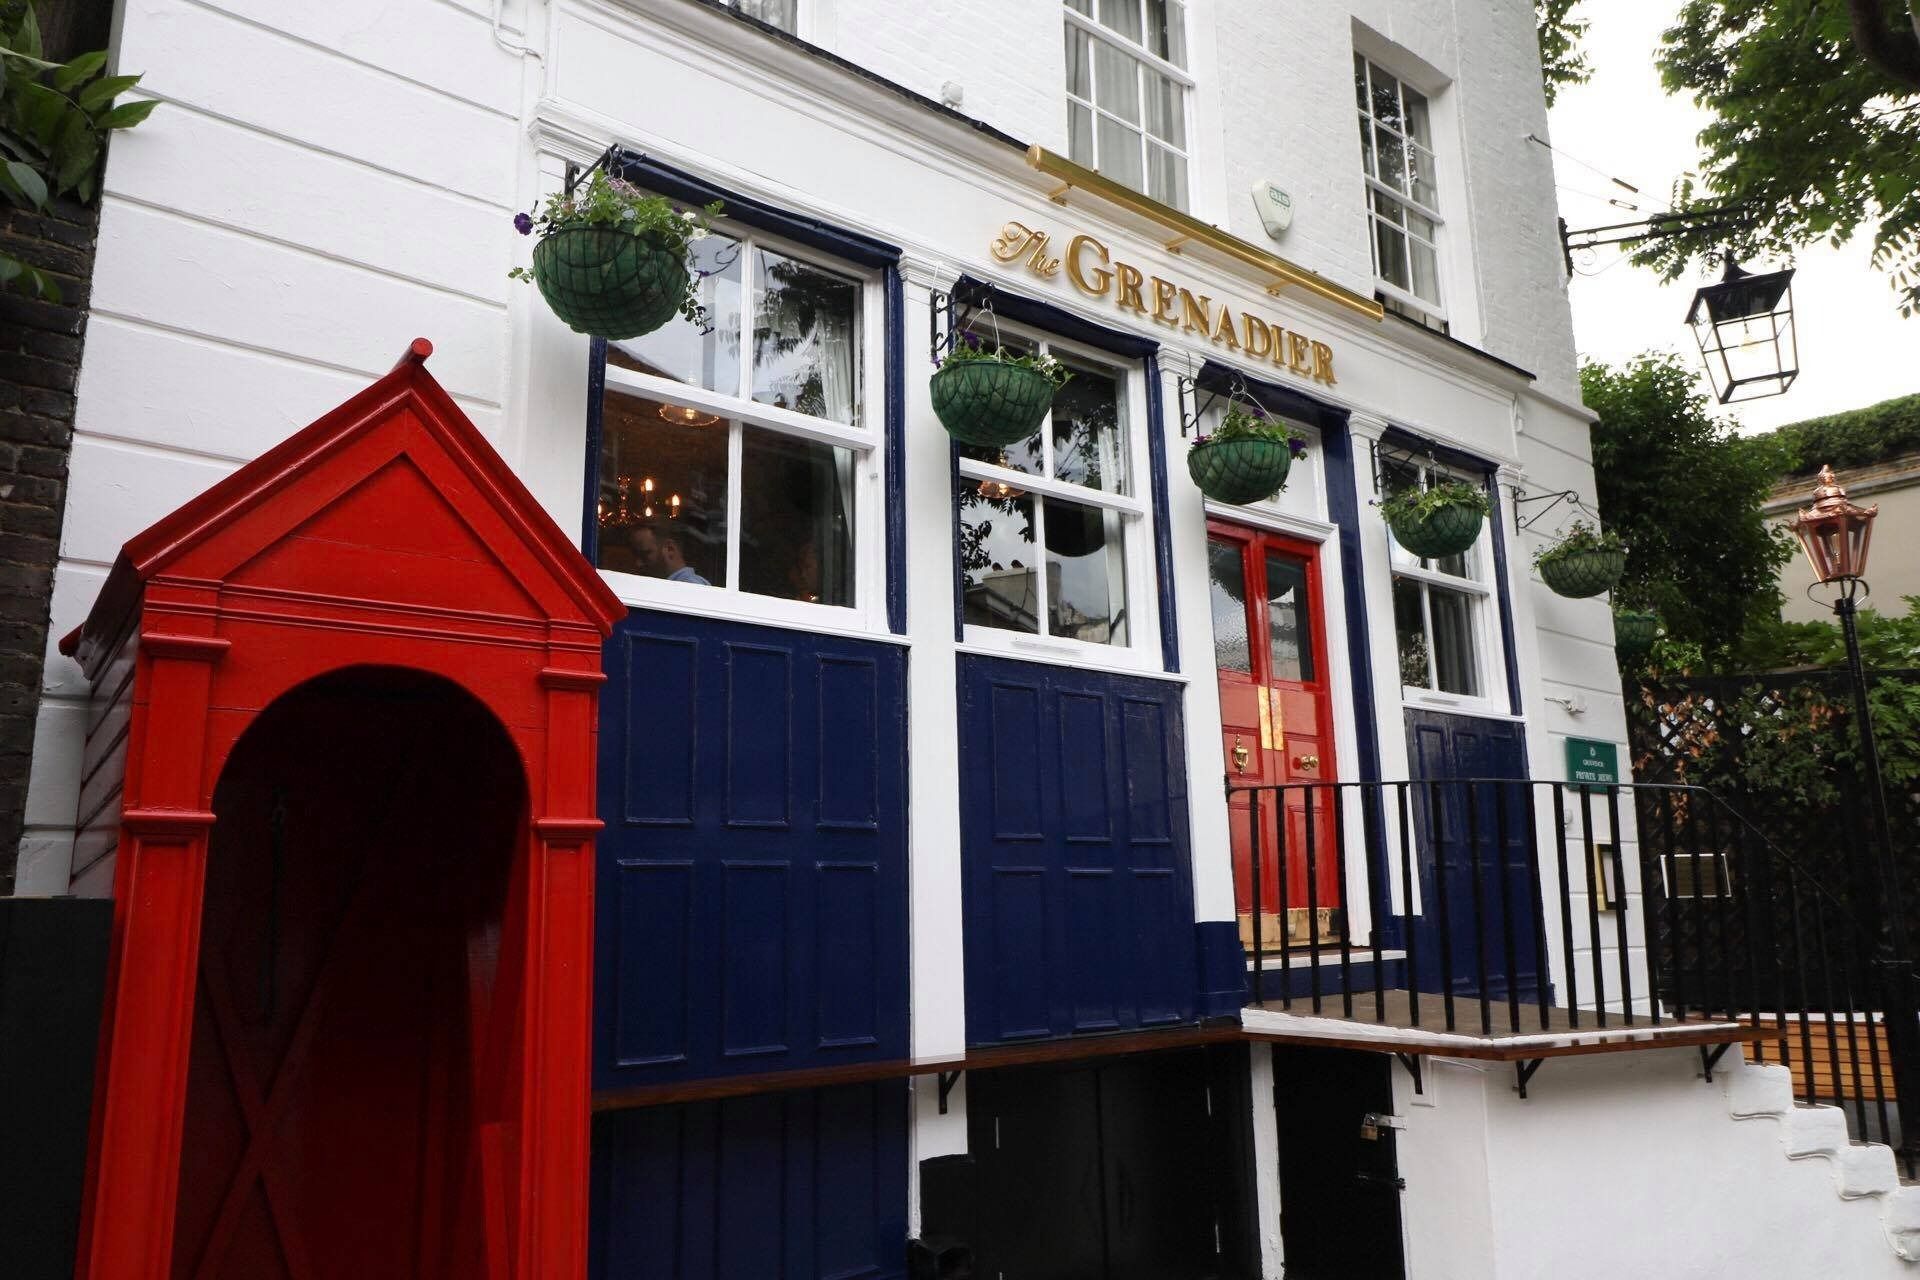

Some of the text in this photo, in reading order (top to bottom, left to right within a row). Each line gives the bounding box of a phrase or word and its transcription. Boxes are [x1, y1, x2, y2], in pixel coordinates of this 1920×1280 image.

[990, 221, 1338, 385] The GRENADIER
[1575, 770, 1597, 781] PRIVATE
